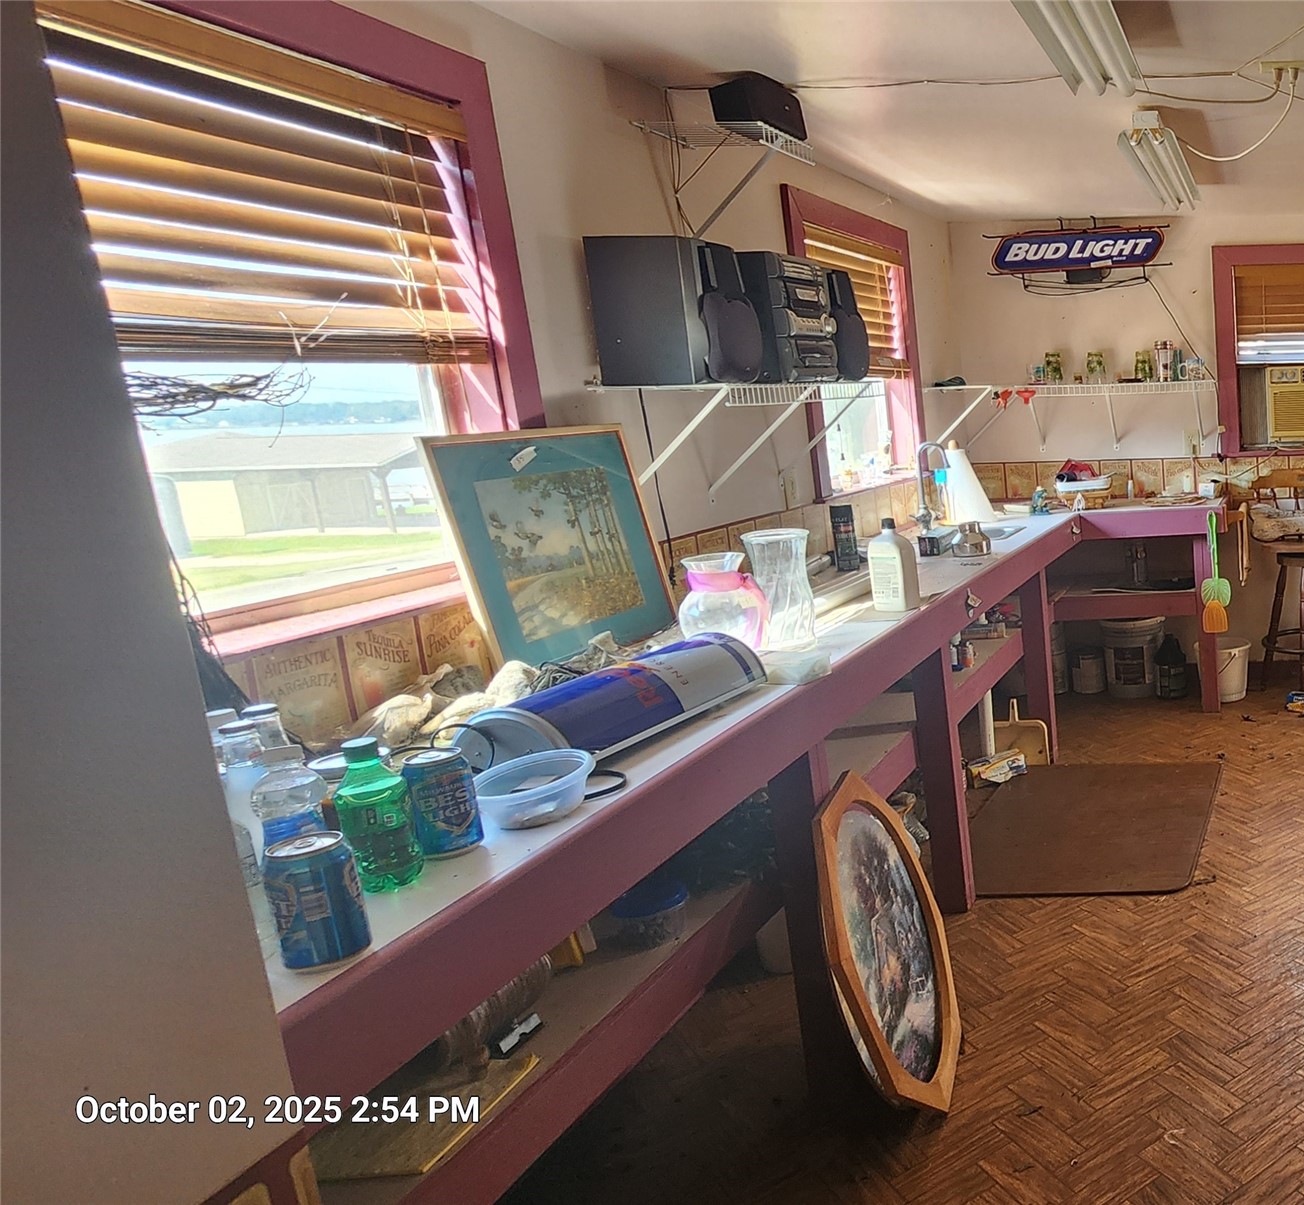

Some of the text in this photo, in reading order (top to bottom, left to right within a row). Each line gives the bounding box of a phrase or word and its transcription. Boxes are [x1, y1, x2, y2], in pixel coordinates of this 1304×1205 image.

[1004, 238, 1153, 262] BUD LIGHT
[365, 629, 405, 650] TEQUILA
[265, 649, 331, 680] AUTHENTIC
[356, 642, 411, 664] SUNRISE
[265, 672, 339, 700] MARGARITA
[420, 787, 470, 811] BES
[423, 801, 471, 822] LIGH
